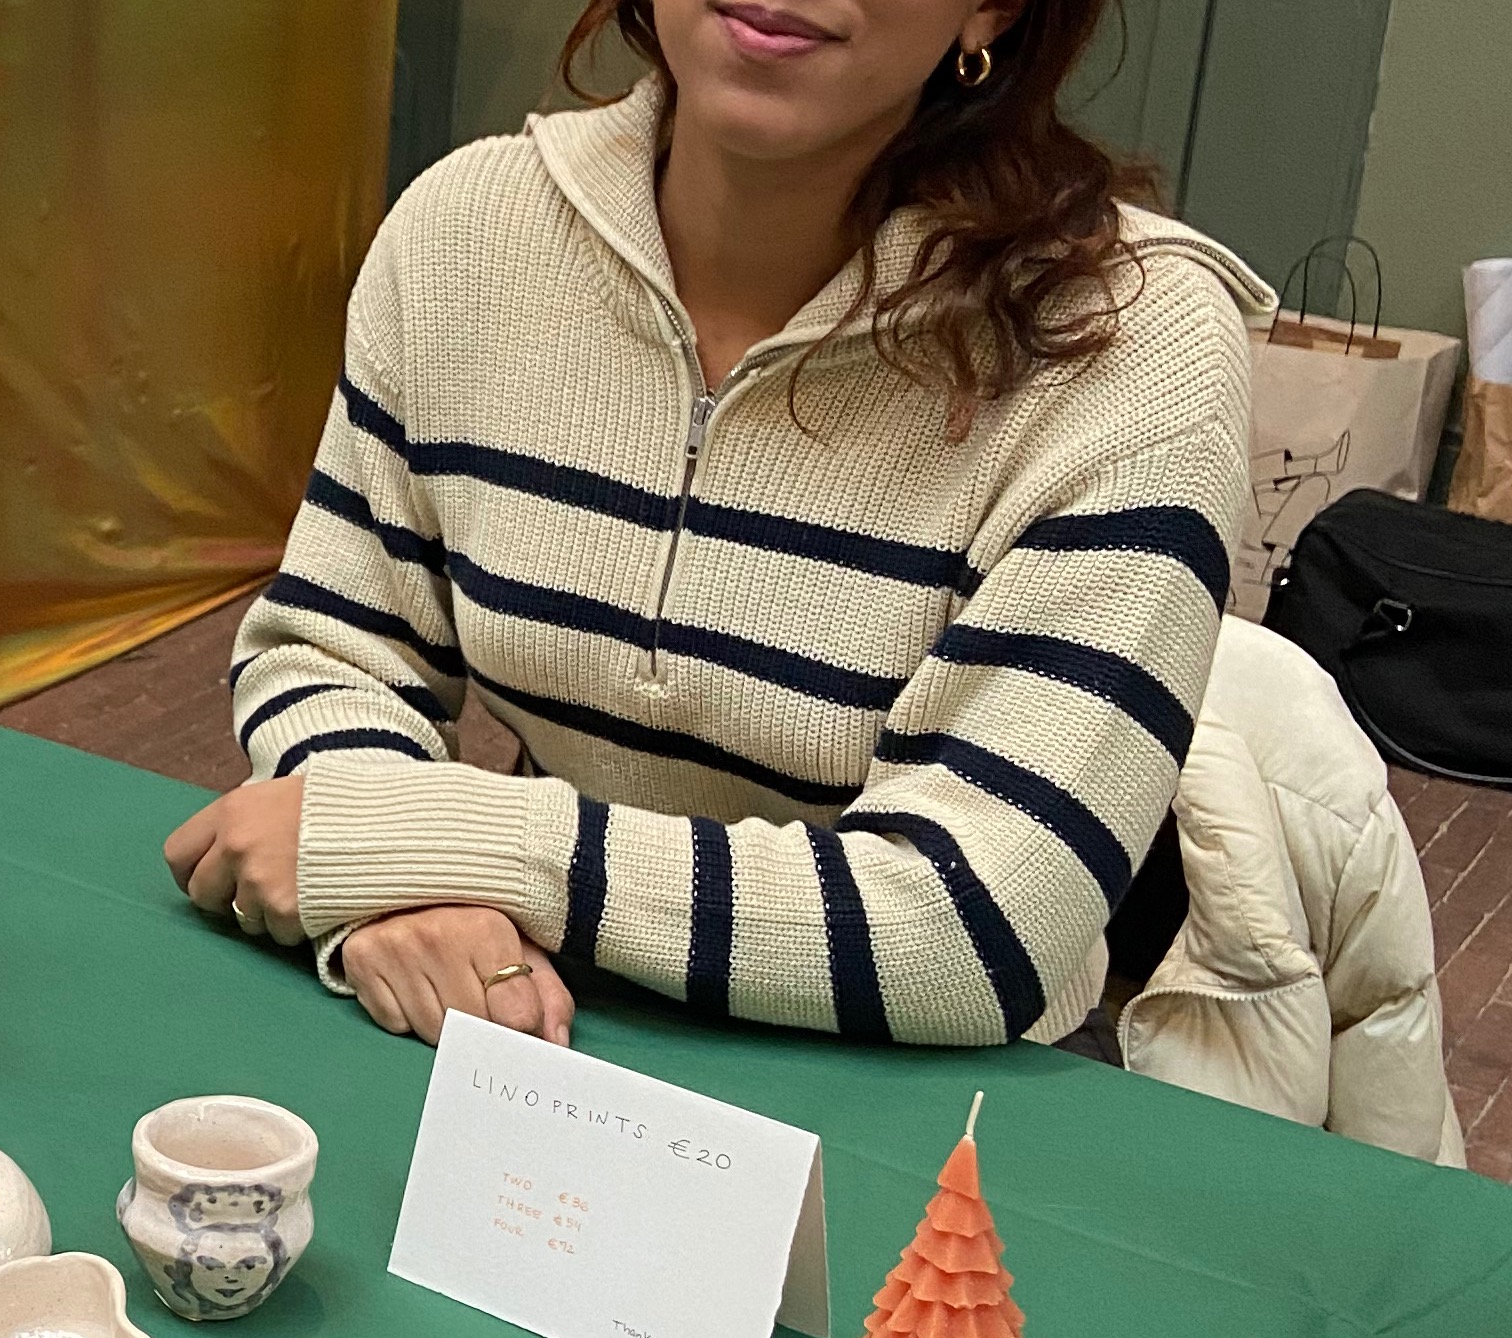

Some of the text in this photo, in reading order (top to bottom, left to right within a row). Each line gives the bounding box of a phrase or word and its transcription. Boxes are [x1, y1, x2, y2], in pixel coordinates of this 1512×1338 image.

[667, 1138, 732, 1170] €20
[503, 1172, 532, 1190] TWO
[498, 1194, 542, 1219] THREE
[493, 1217, 524, 1237] FOUR
